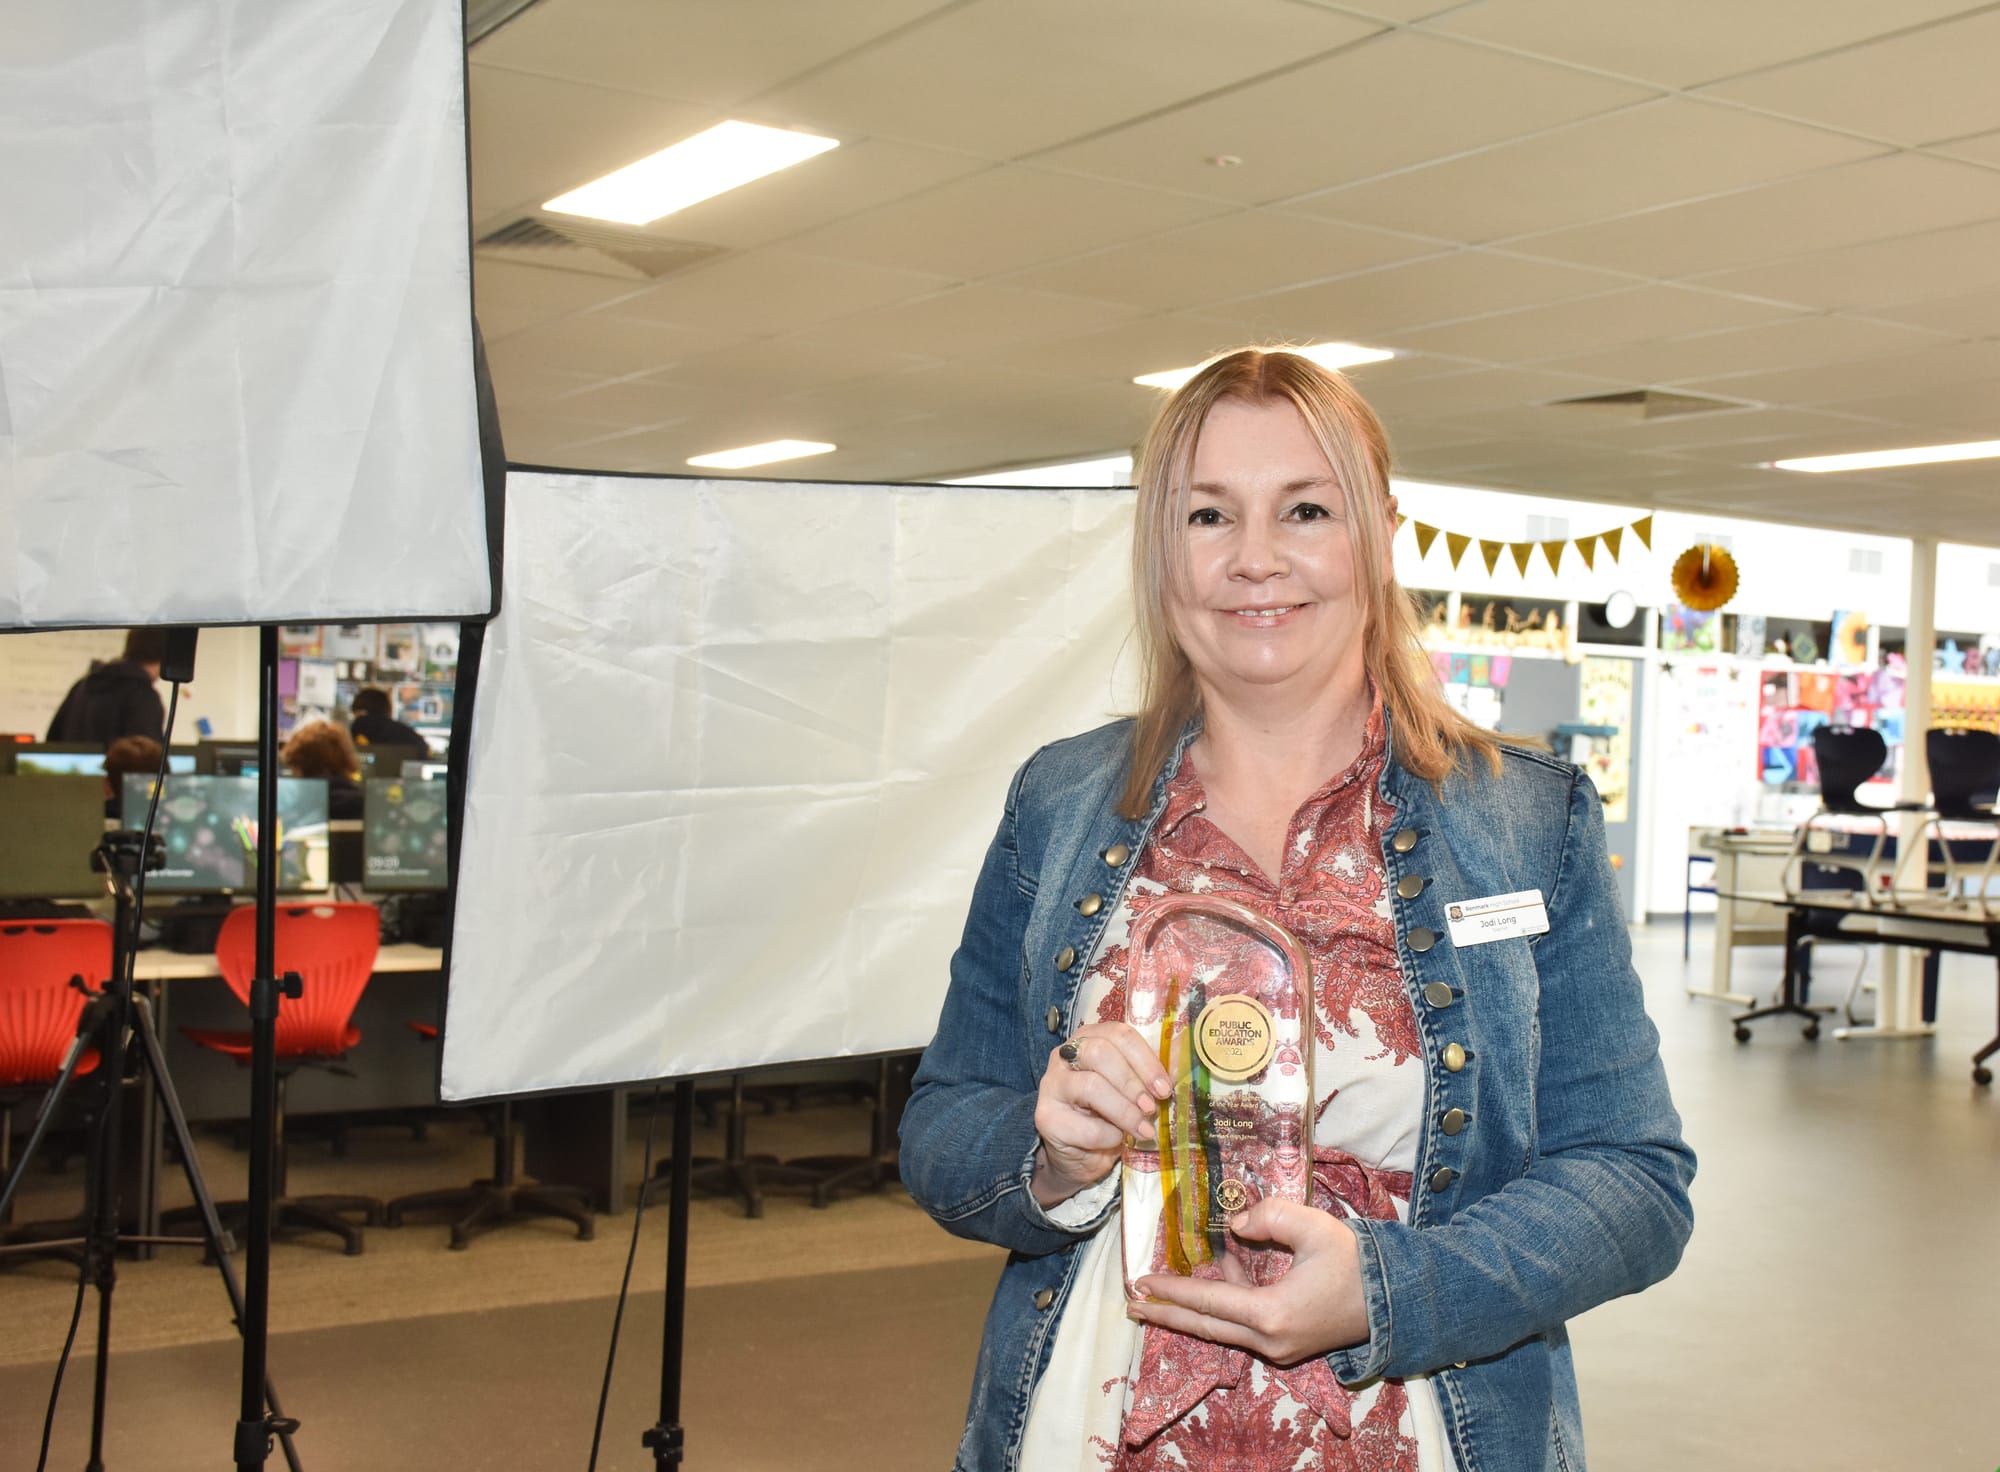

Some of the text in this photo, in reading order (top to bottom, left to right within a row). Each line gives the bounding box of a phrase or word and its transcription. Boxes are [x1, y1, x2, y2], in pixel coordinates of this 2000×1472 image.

[1480, 916, 1517, 928] Jodi Long
[1219, 1021, 1252, 1029] PUBLIC
[1209, 1028, 1262, 1038] EDUCATION
[1215, 1038, 1255, 1046] AWARDS
[1224, 1047, 1243, 1056] 2021
[1213, 1119, 1254, 1129] Jodi Long
